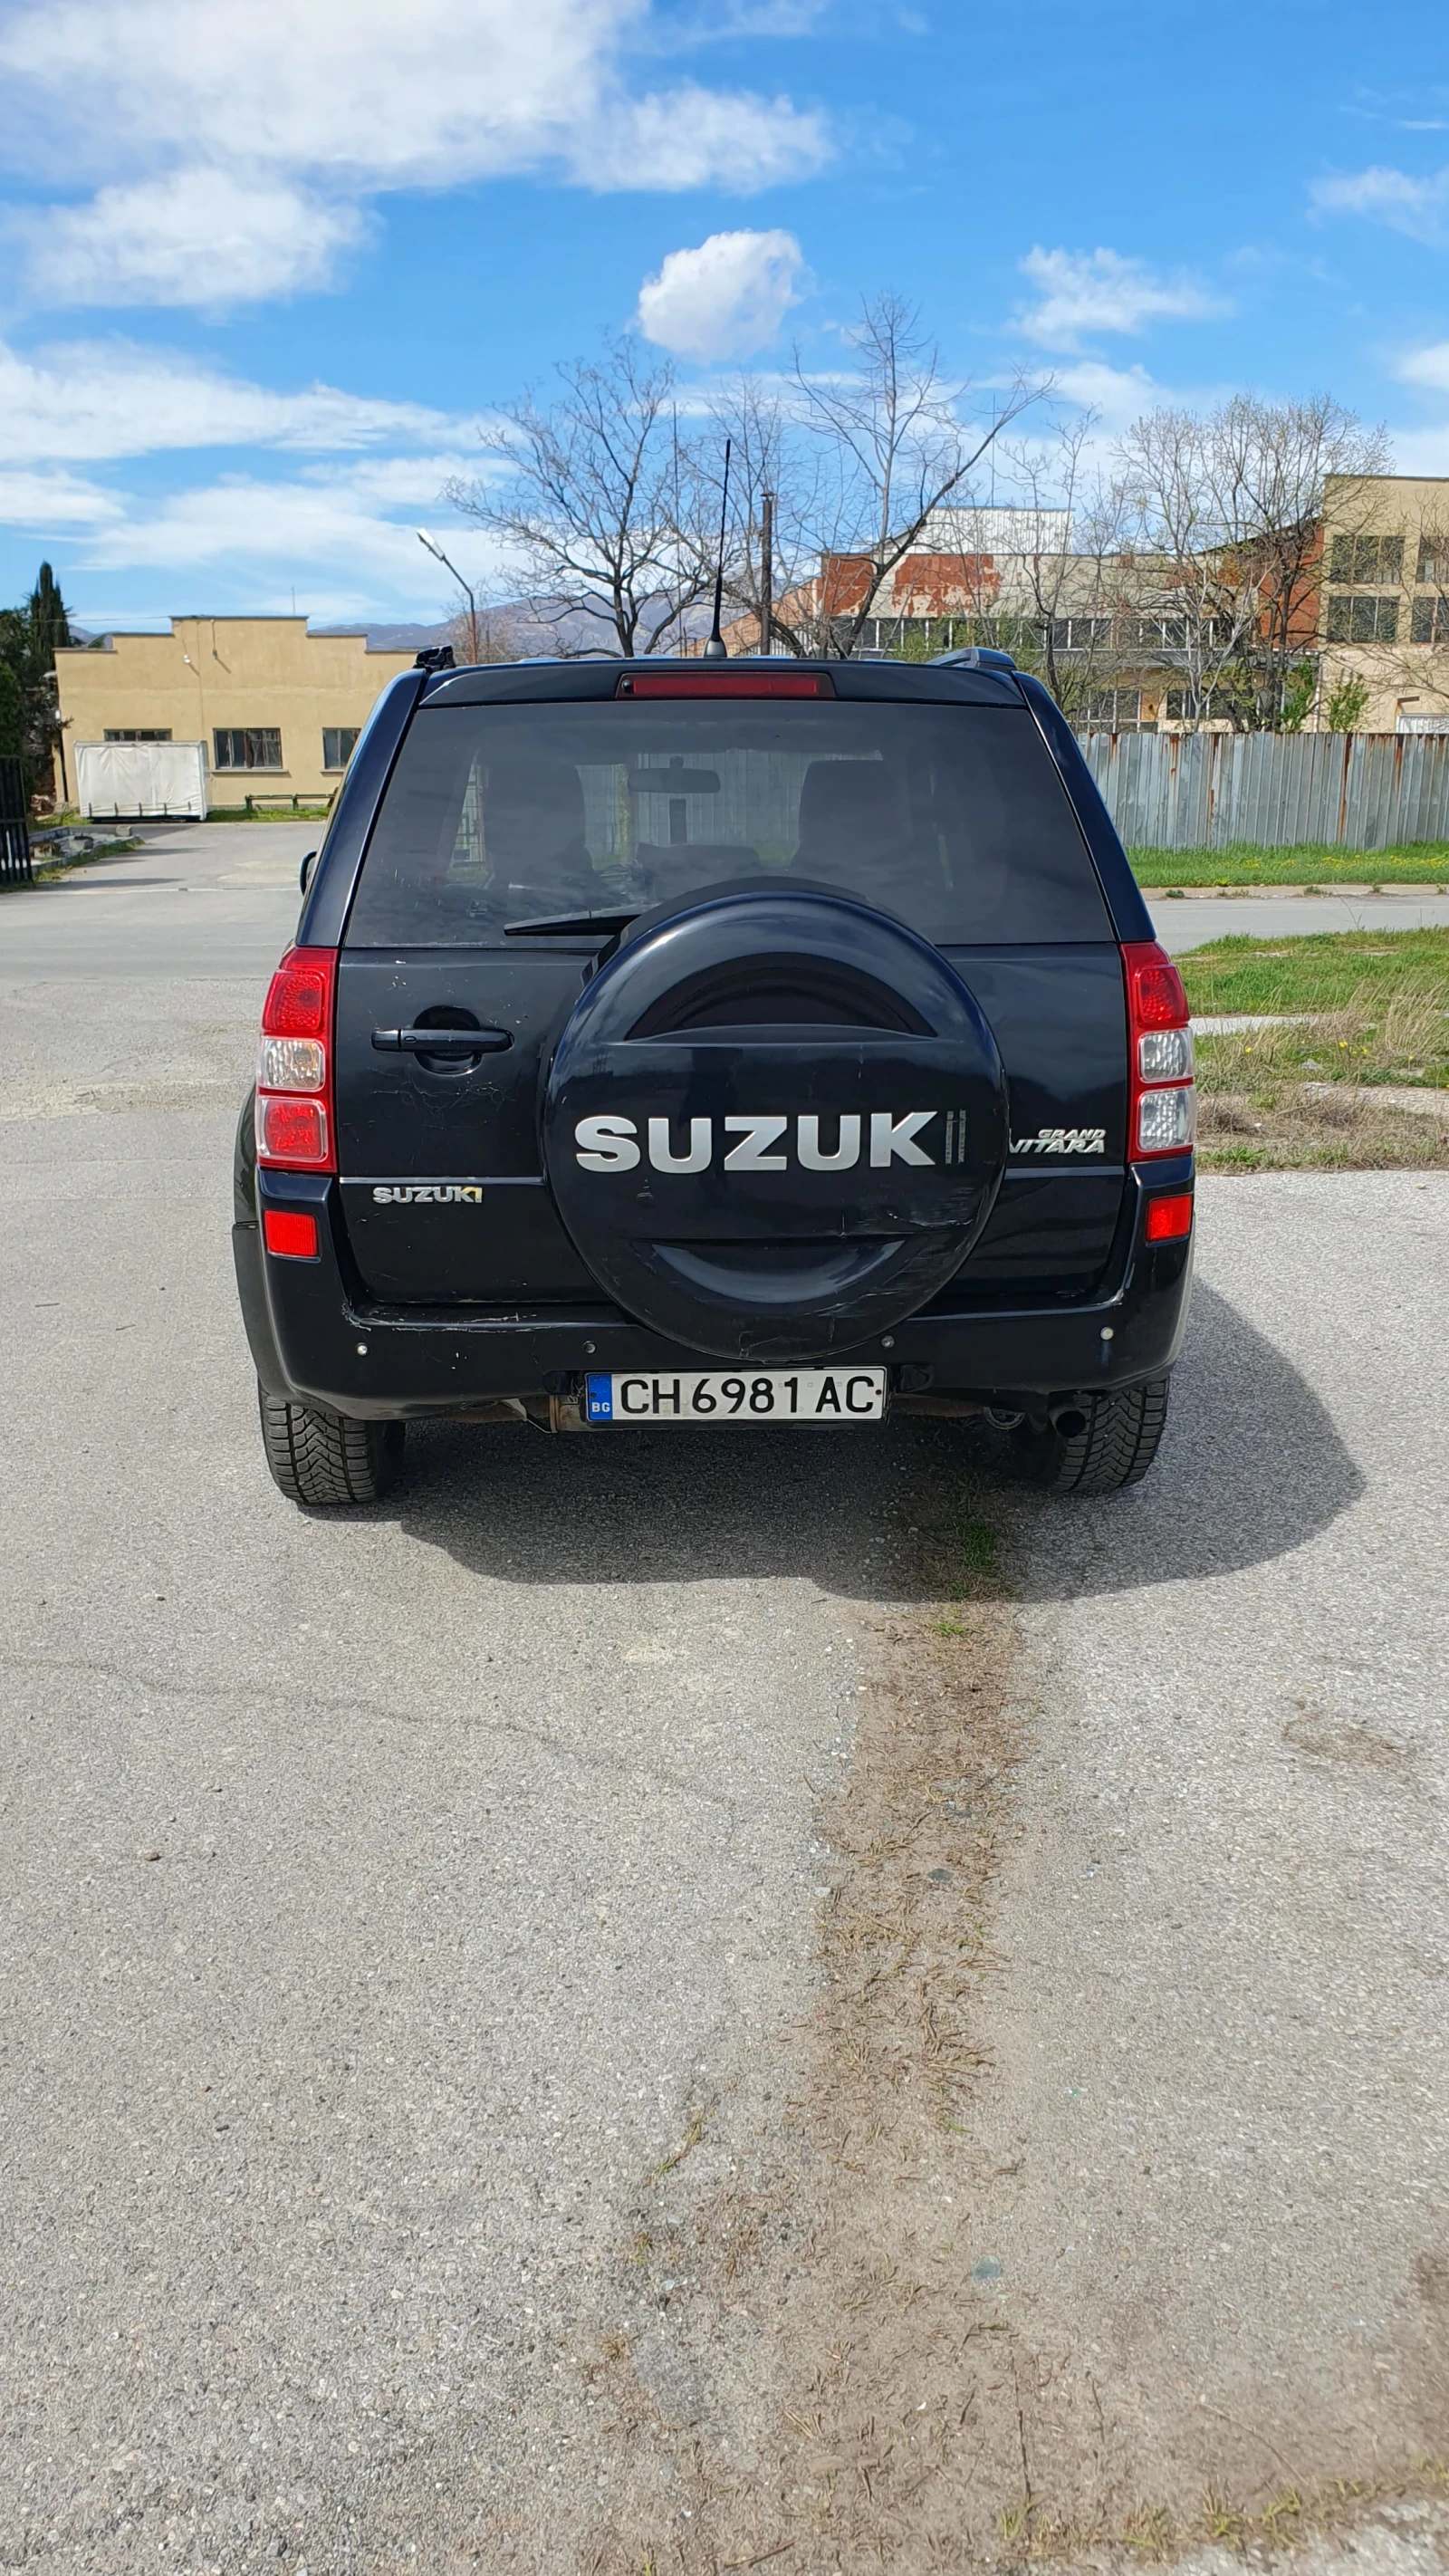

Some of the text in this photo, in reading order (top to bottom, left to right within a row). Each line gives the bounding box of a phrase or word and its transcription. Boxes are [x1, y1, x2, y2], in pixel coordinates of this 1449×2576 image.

[1038, 1129, 1107, 1140] GRAND
[1009, 1134, 1105, 1154] VITARA
[372, 1186, 483, 1204] SUZUKI
[591, 1401, 610, 1413] BG
